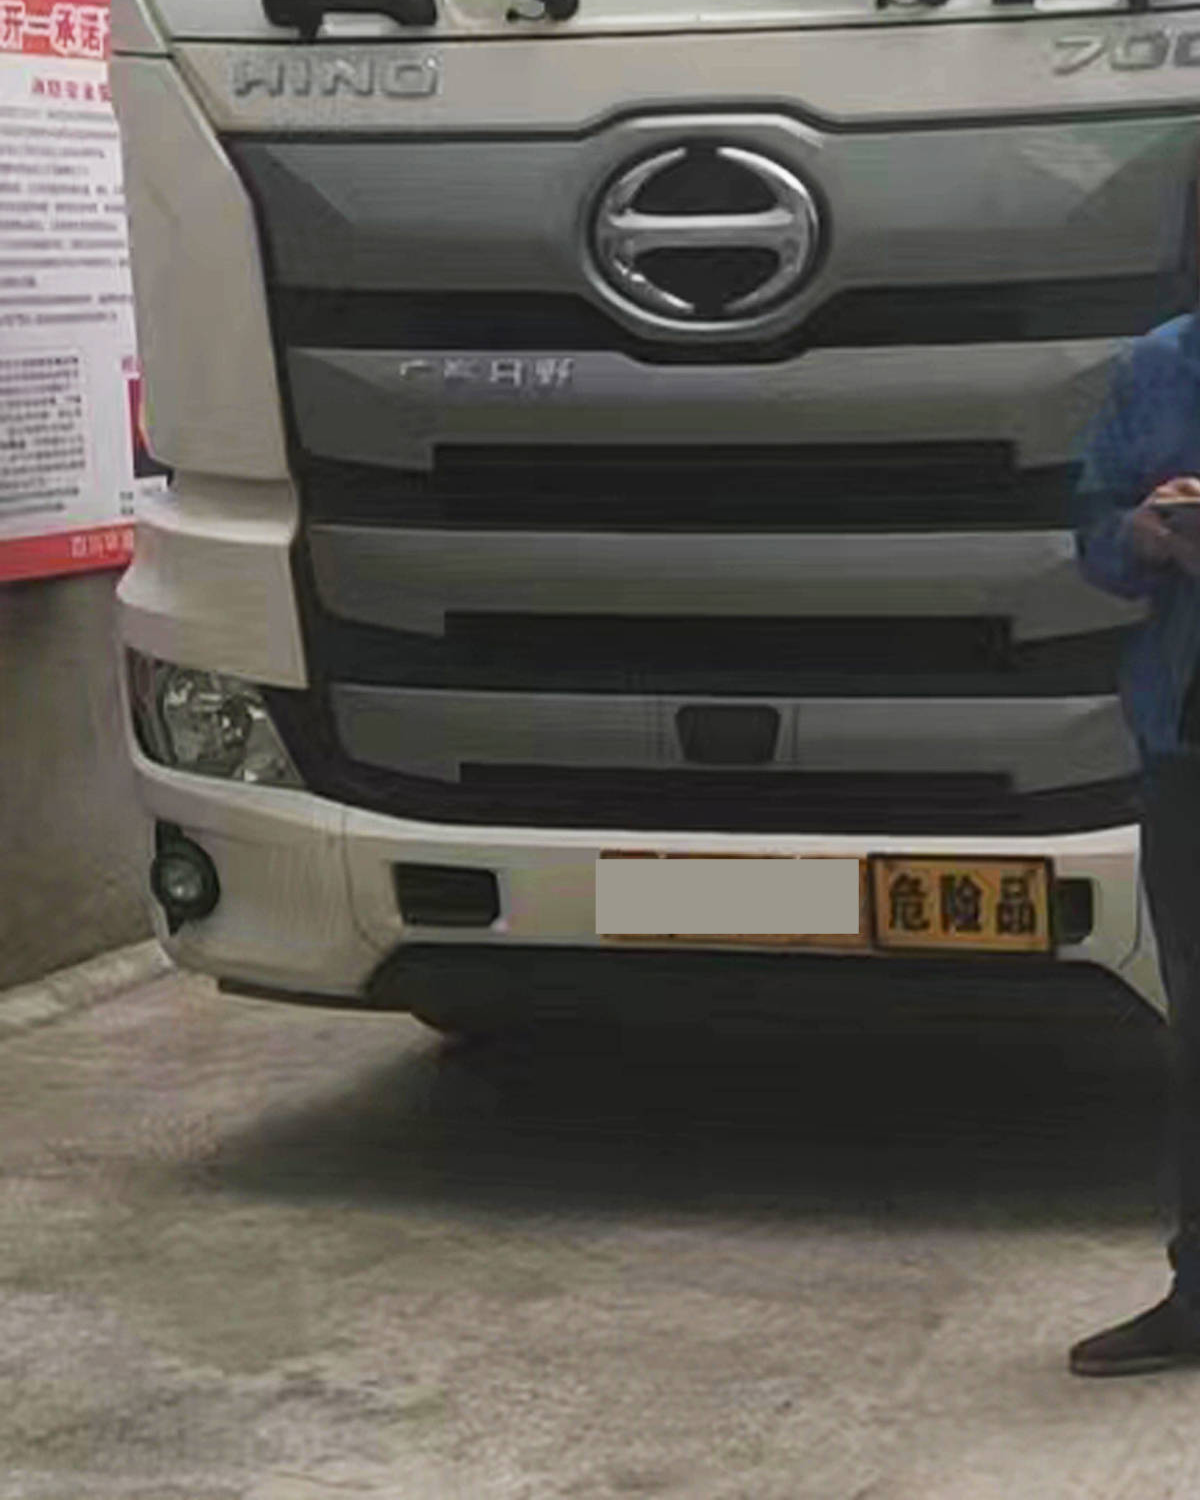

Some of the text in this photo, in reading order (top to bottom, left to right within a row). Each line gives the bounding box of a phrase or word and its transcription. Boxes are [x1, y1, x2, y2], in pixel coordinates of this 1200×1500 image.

[230, 53, 439, 99] HINO
[886, 871, 1039, 934] 危险品
